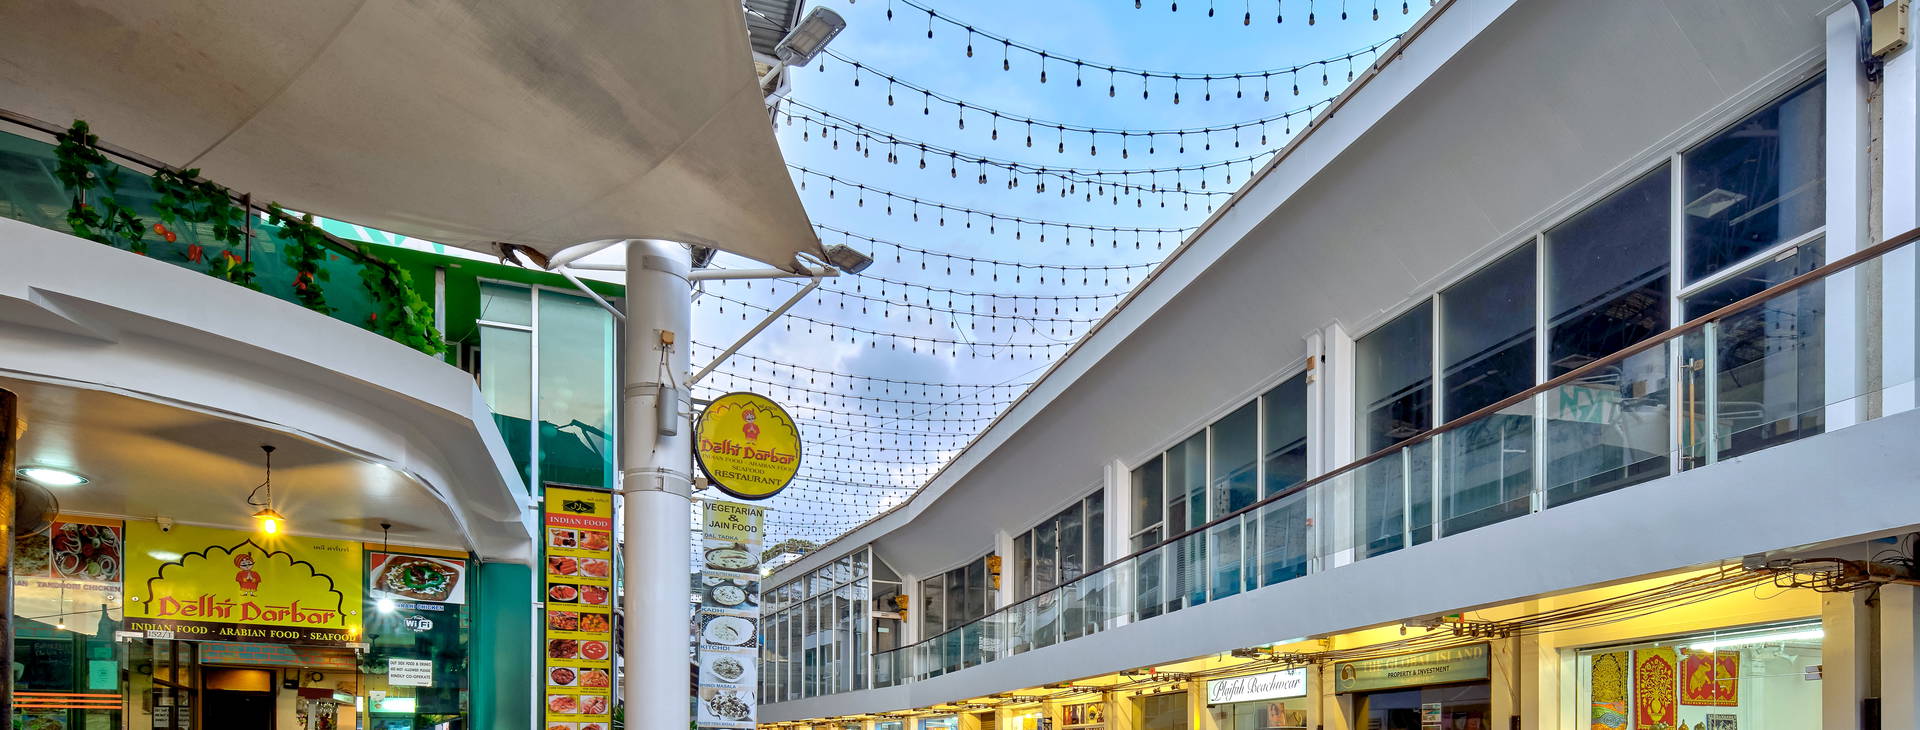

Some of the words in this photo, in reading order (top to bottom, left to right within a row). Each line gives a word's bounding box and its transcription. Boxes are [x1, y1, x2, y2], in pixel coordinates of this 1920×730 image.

[701, 440, 742, 456] Delhi
[743, 447, 795, 464] Darbar
[702, 454, 723, 462] INDIAN
[725, 456, 743, 464] FOOD
[749, 461, 776, 470] ARABIAN
[732, 465, 765, 474] SEAFOOD
[714, 469, 782, 486] RESTAURANT
[705, 503, 763, 517] VEGETARIAN
[550, 516, 581, 525] INDIAN
[584, 519, 608, 527] FOOD
[728, 514, 739, 522] &
[709, 521, 730, 529] JAIN
[732, 524, 757, 532] FOOD
[37, 582, 81, 590] TANDOORI
[83, 584, 121, 592] CHICKEN
[157, 593, 236, 618] Delhi
[240, 600, 336, 624] Darbar
[131, 622, 171, 632] INDIAN
[176, 625, 208, 634] FOOD
[219, 627, 266, 637] ARABIAN
[271, 631, 300, 639] FOOD
[310, 632, 357, 641] SEAFOOD
[1435, 646, 1483, 662] ISLAND
[1388, 670, 1412, 678] PROPERTY
[1418, 666, 1450, 675] INVESTMENT
[1247, 674, 1301, 694] Beachwear
